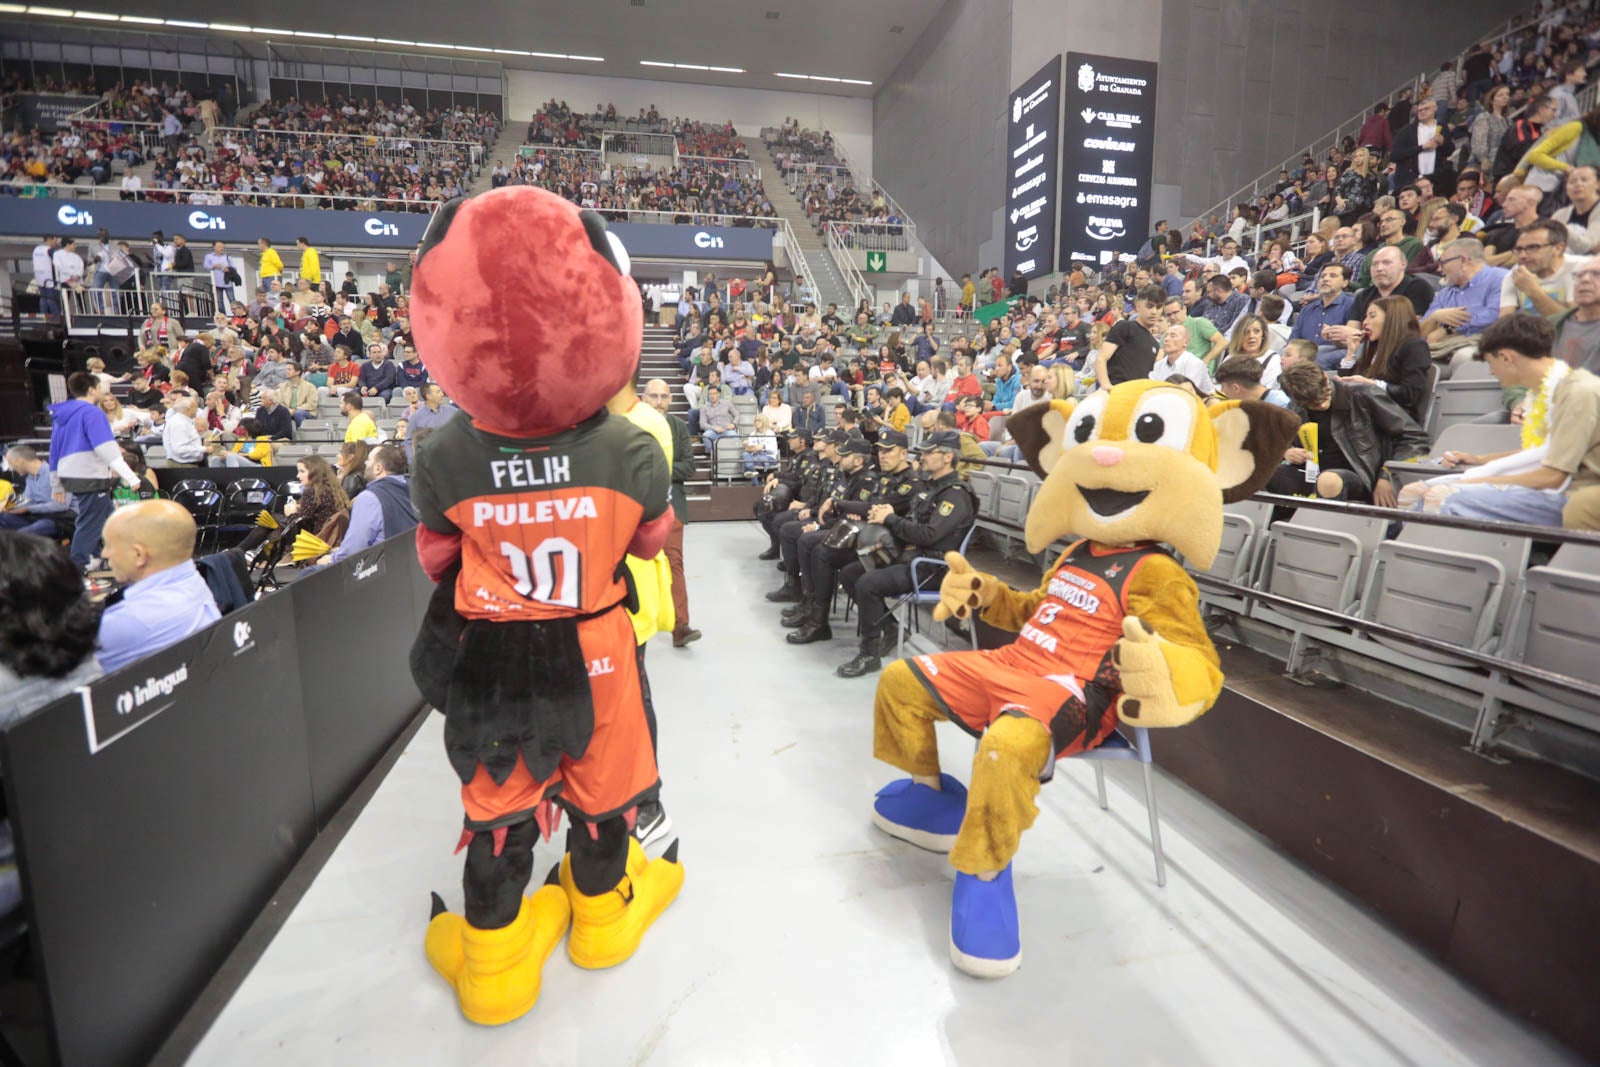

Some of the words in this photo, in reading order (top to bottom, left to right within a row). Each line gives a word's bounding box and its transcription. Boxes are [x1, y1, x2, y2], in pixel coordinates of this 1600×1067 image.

[1086, 194, 1138, 208] emasagra
[490, 455, 570, 488] FÉLIX
[473, 496, 598, 527] PULEVA
[134, 667, 188, 706] inlingua
